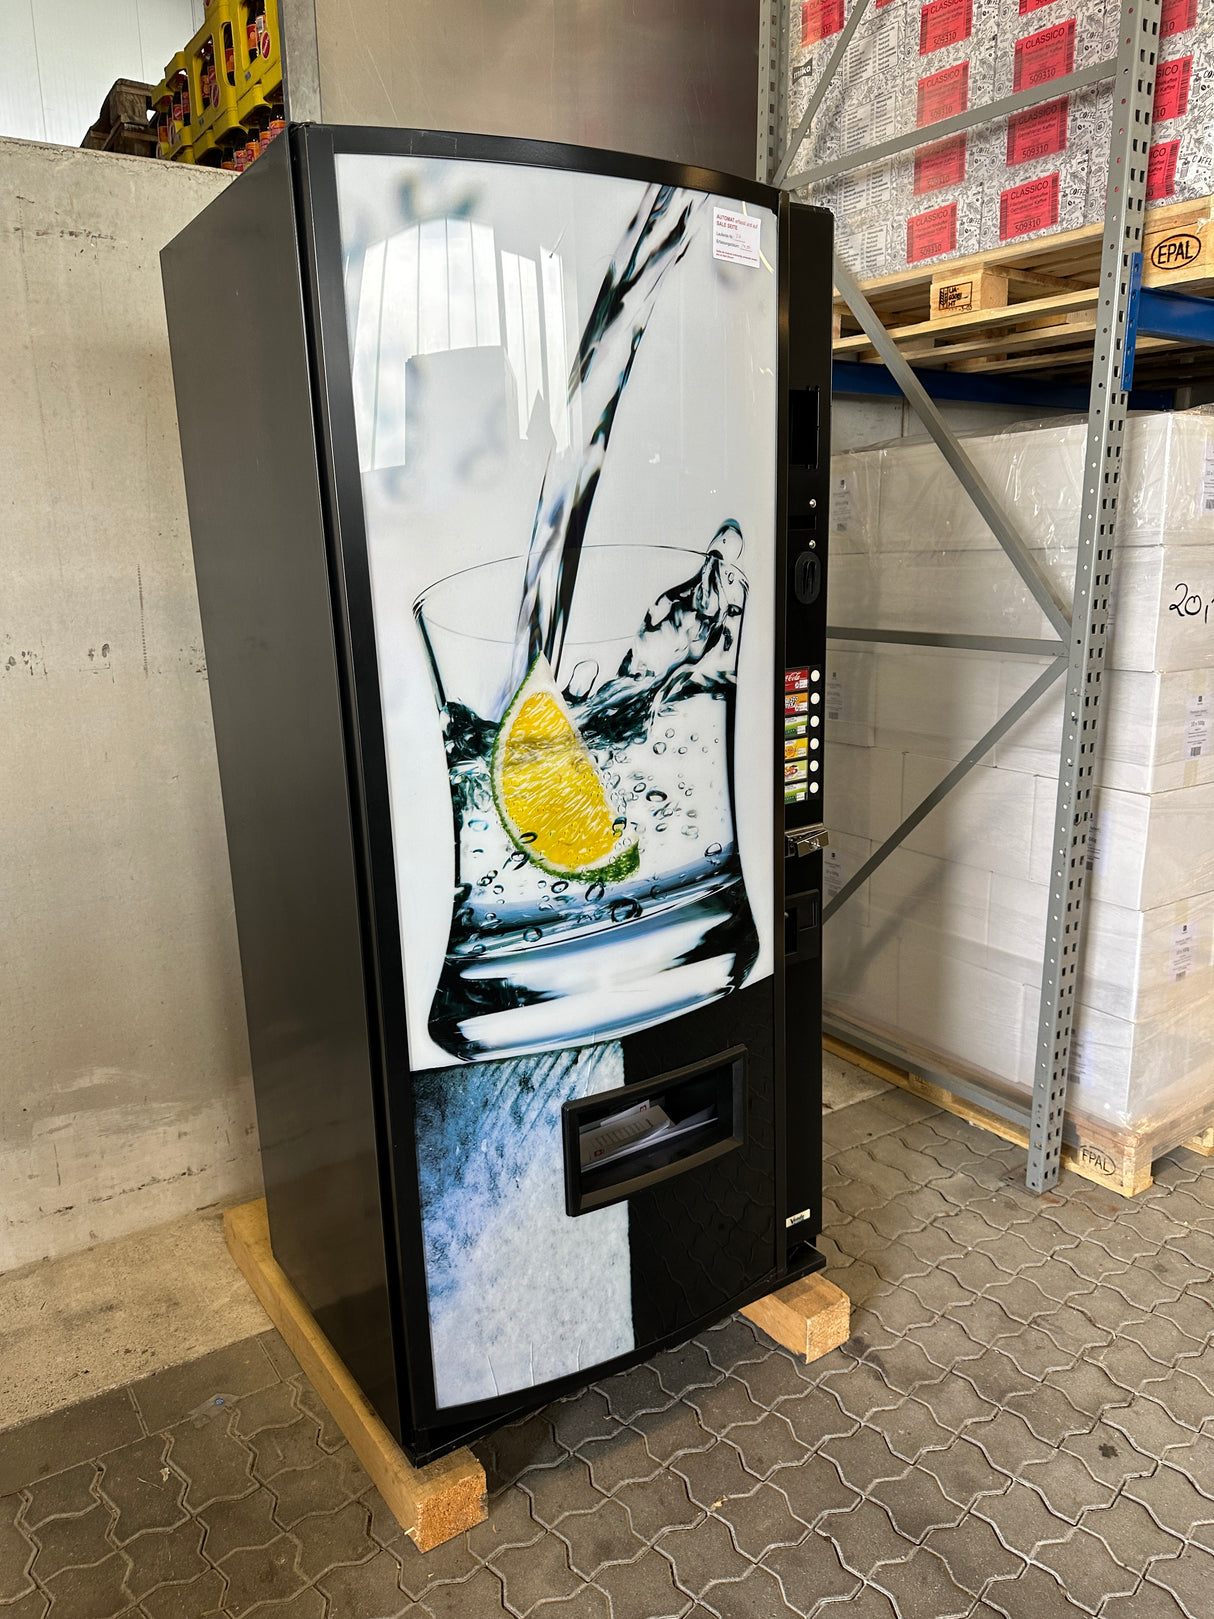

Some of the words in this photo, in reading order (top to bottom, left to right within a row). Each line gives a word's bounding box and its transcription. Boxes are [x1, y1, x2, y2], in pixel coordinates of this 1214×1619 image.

[930, 0, 963, 14] CLASSIC
[1025, 27, 1065, 50] CLASSICO
[793, 65, 811, 80] miko
[926, 68, 960, 88] CLASSICO
[1029, 67, 1056, 85] 509310
[1017, 104, 1057, 125] CLASSICO
[1022, 143, 1049, 159] 509310
[1010, 180, 1049, 200] CLASSICO
[716, 214, 735, 222] AUTOMAT
[716, 220, 726, 228] SALE
[915, 209, 949, 227] CLASSICO
[1015, 218, 1041, 233] 509310
[920, 243, 942, 257] 509310
[1158, 240, 1193, 265] EPAL
[1169, 582, 1214, 625] 20,
